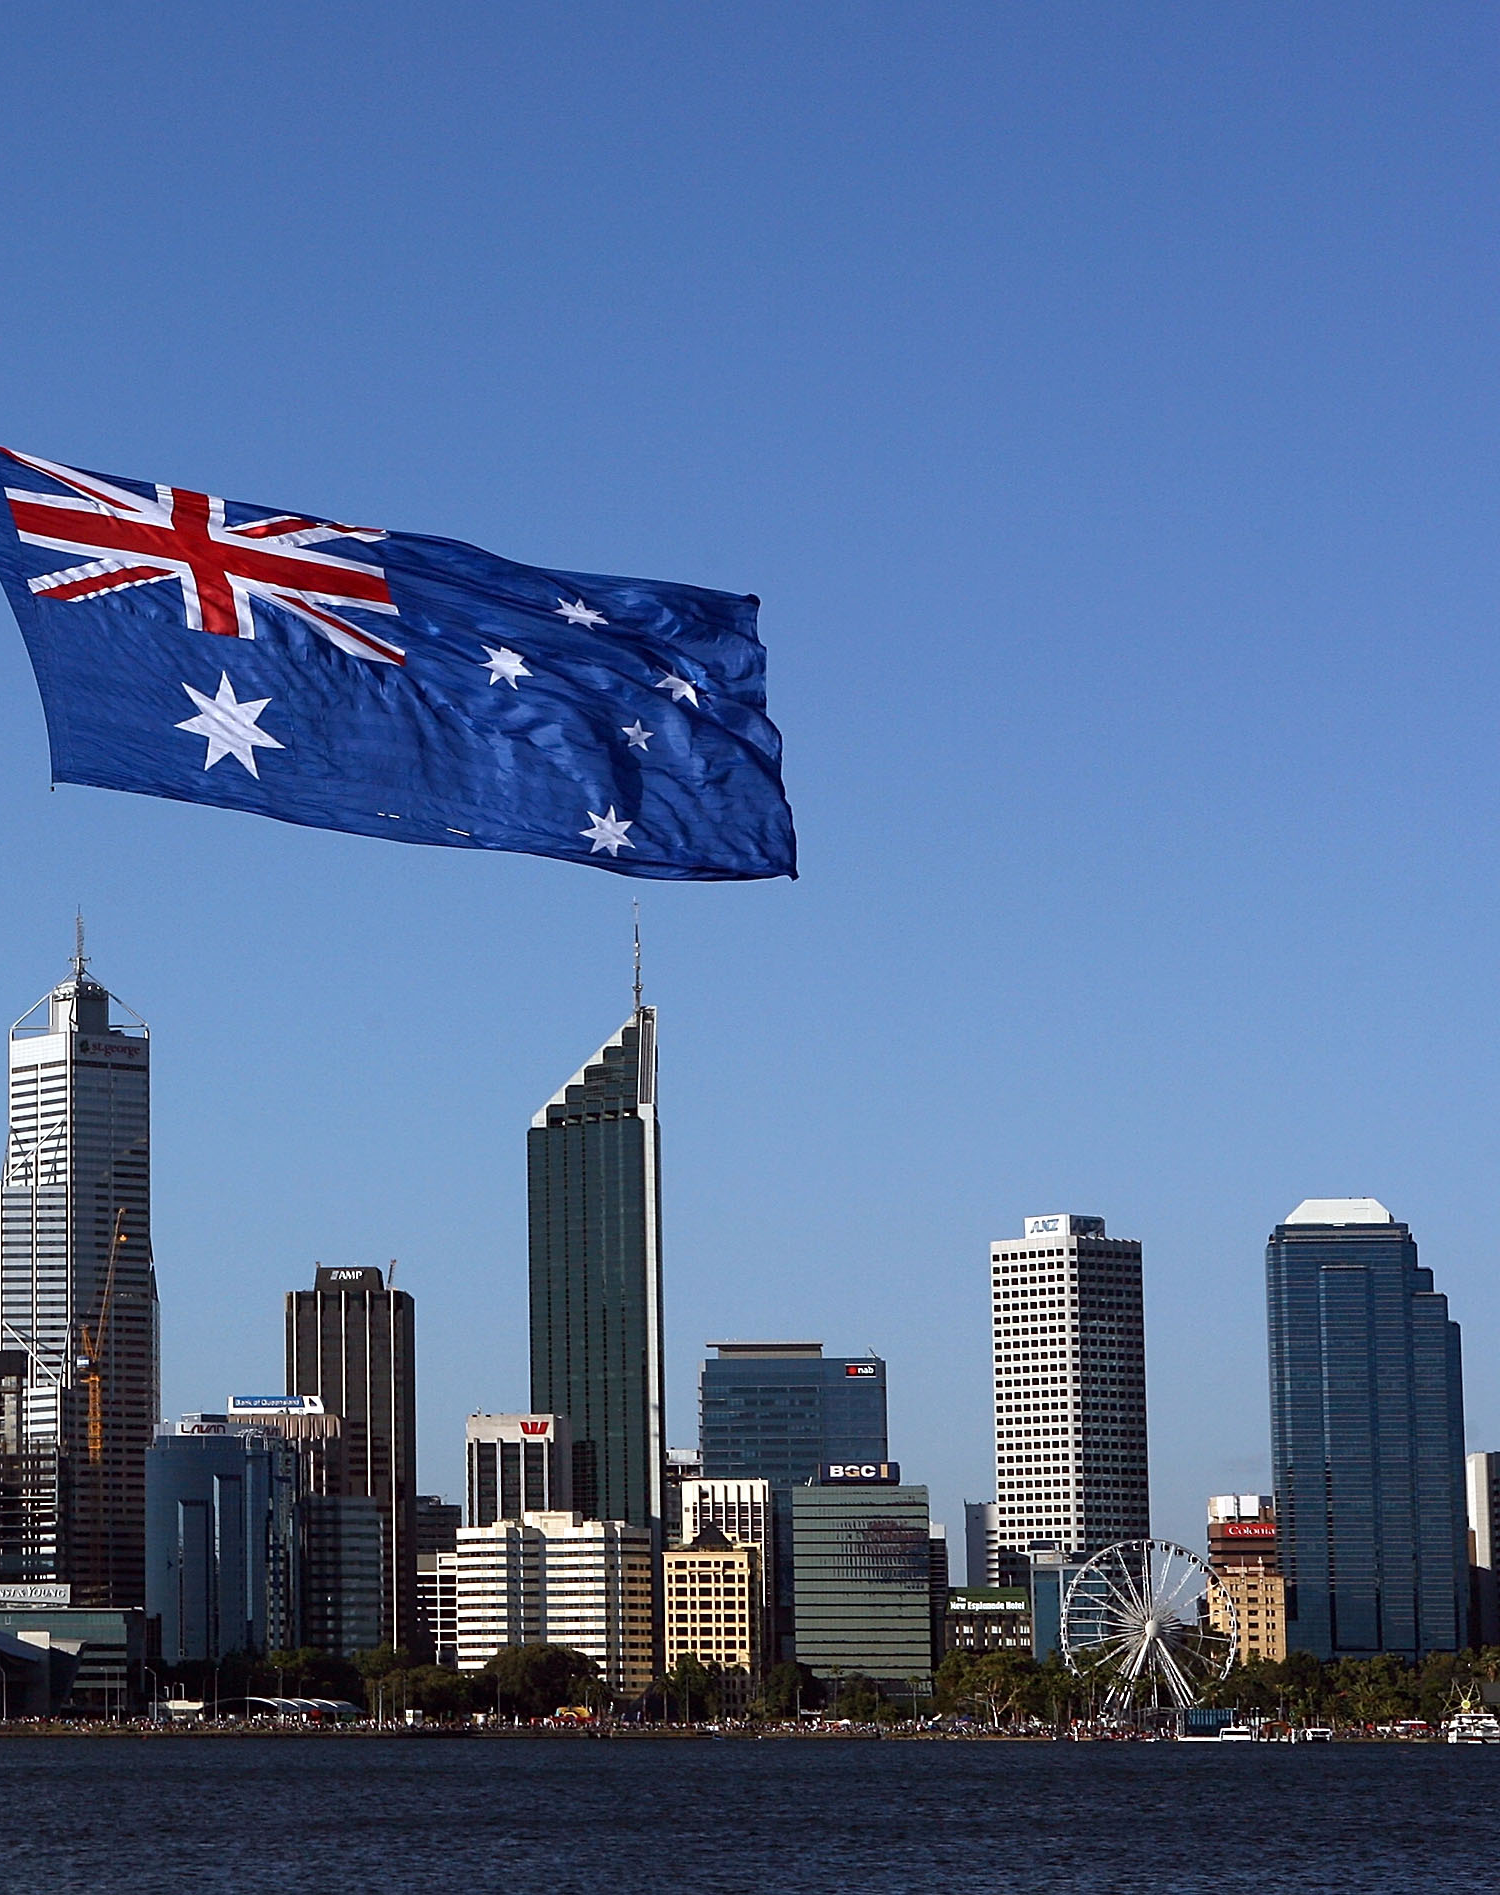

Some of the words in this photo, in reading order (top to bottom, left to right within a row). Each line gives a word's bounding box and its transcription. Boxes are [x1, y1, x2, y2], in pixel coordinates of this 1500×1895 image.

[338, 1270, 363, 1280] AMP
[857, 1365, 875, 1374] nab
[181, 1424, 226, 1434] LAVAN
[829, 1465, 876, 1478] BGC
[1228, 1526, 1275, 1535] Colonia
[26, 1586, 66, 1598] YOUNG
[950, 1601, 966, 1610] New
[967, 1601, 1005, 1611] Esplanade
[1005, 1601, 1025, 1610] Hotel
